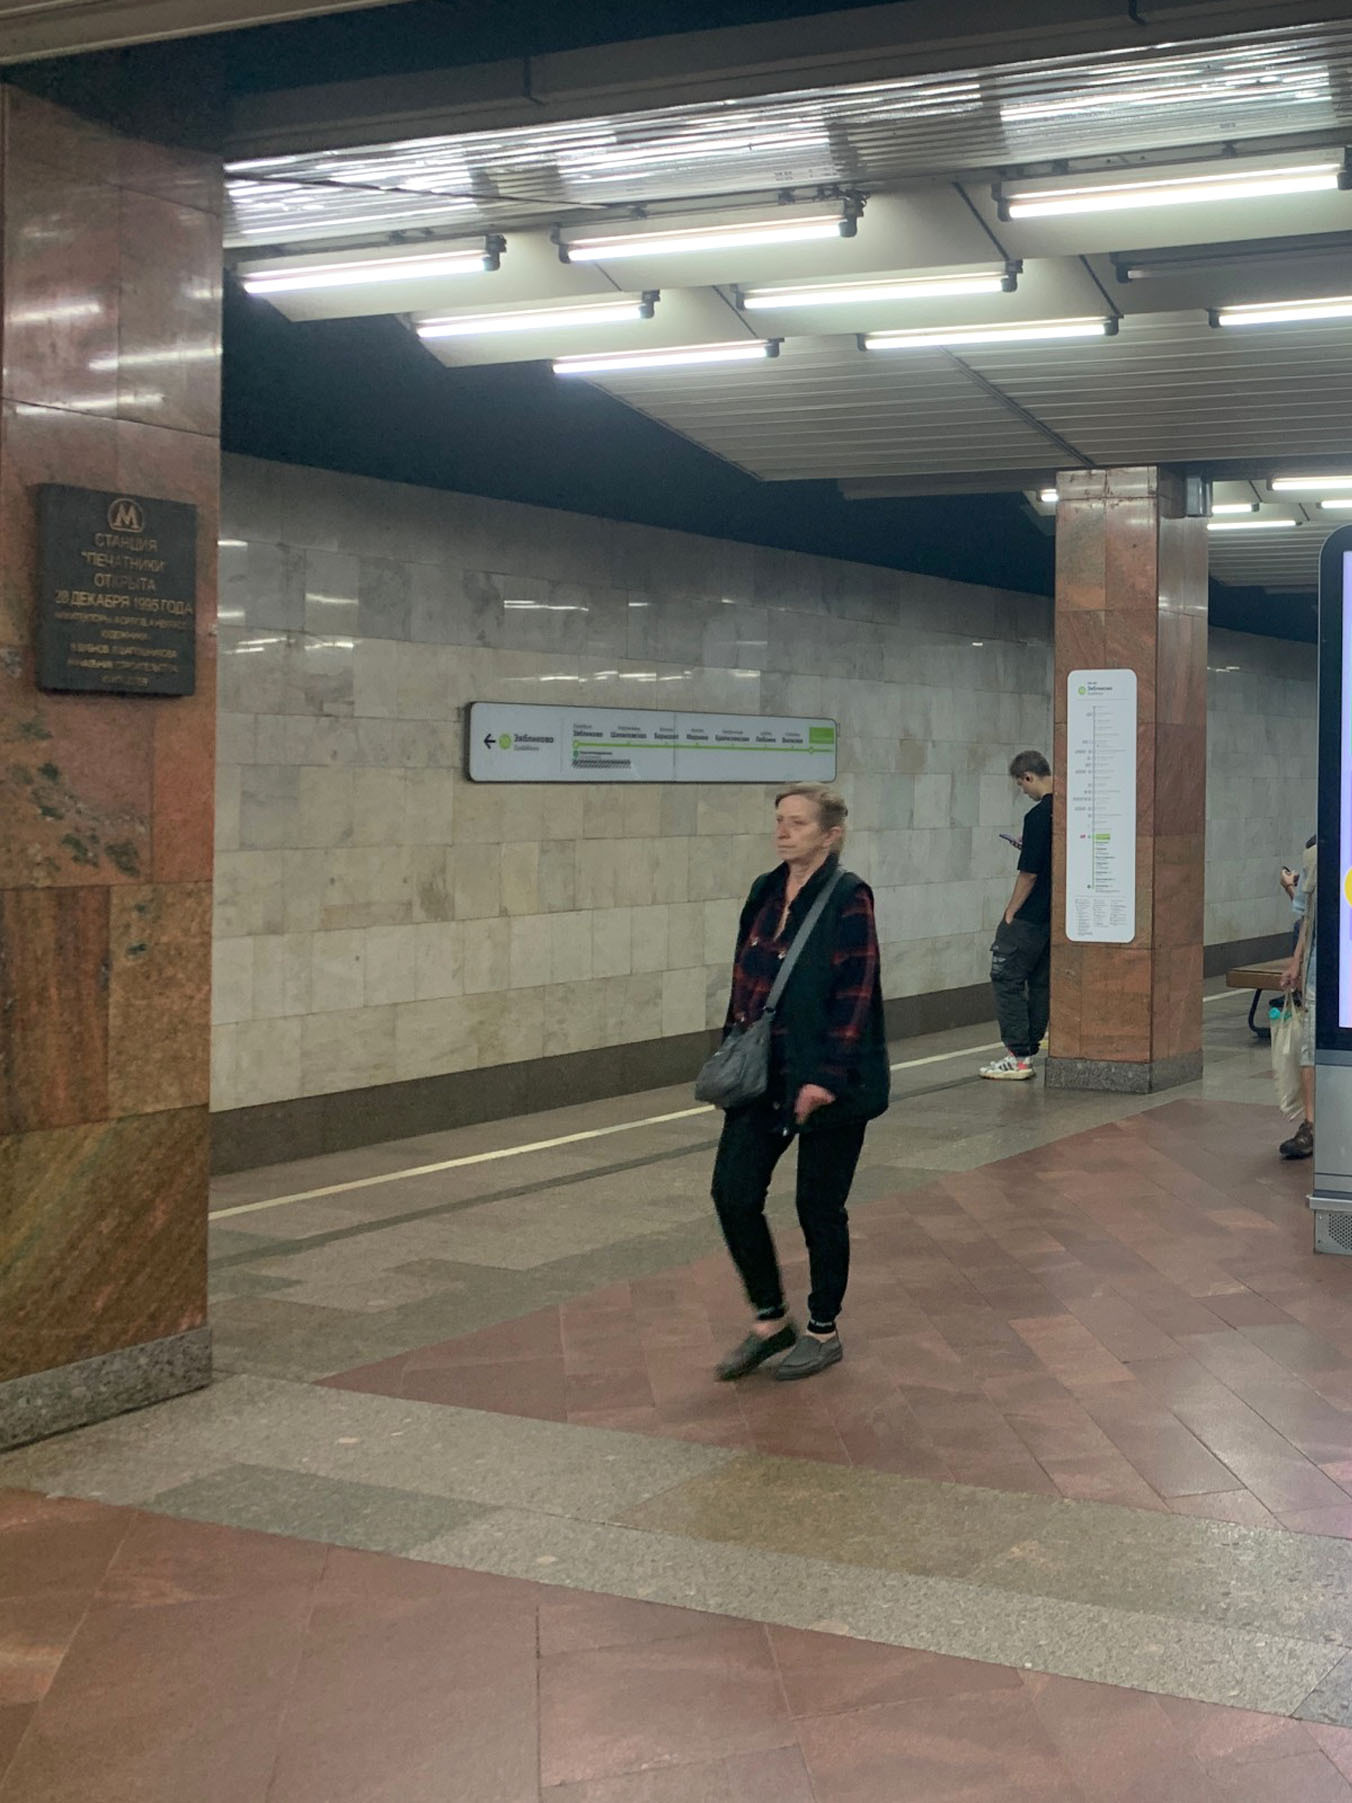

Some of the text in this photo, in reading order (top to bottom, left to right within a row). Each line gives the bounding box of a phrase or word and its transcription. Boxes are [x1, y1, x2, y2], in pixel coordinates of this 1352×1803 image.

[94, 533, 158, 552] СТАНЦИЯ
[94, 573, 156, 592] ОТКРЫТА
[71, 590, 130, 609] ДЕКАБРЯ
[161, 599, 193, 616] ГОДА
